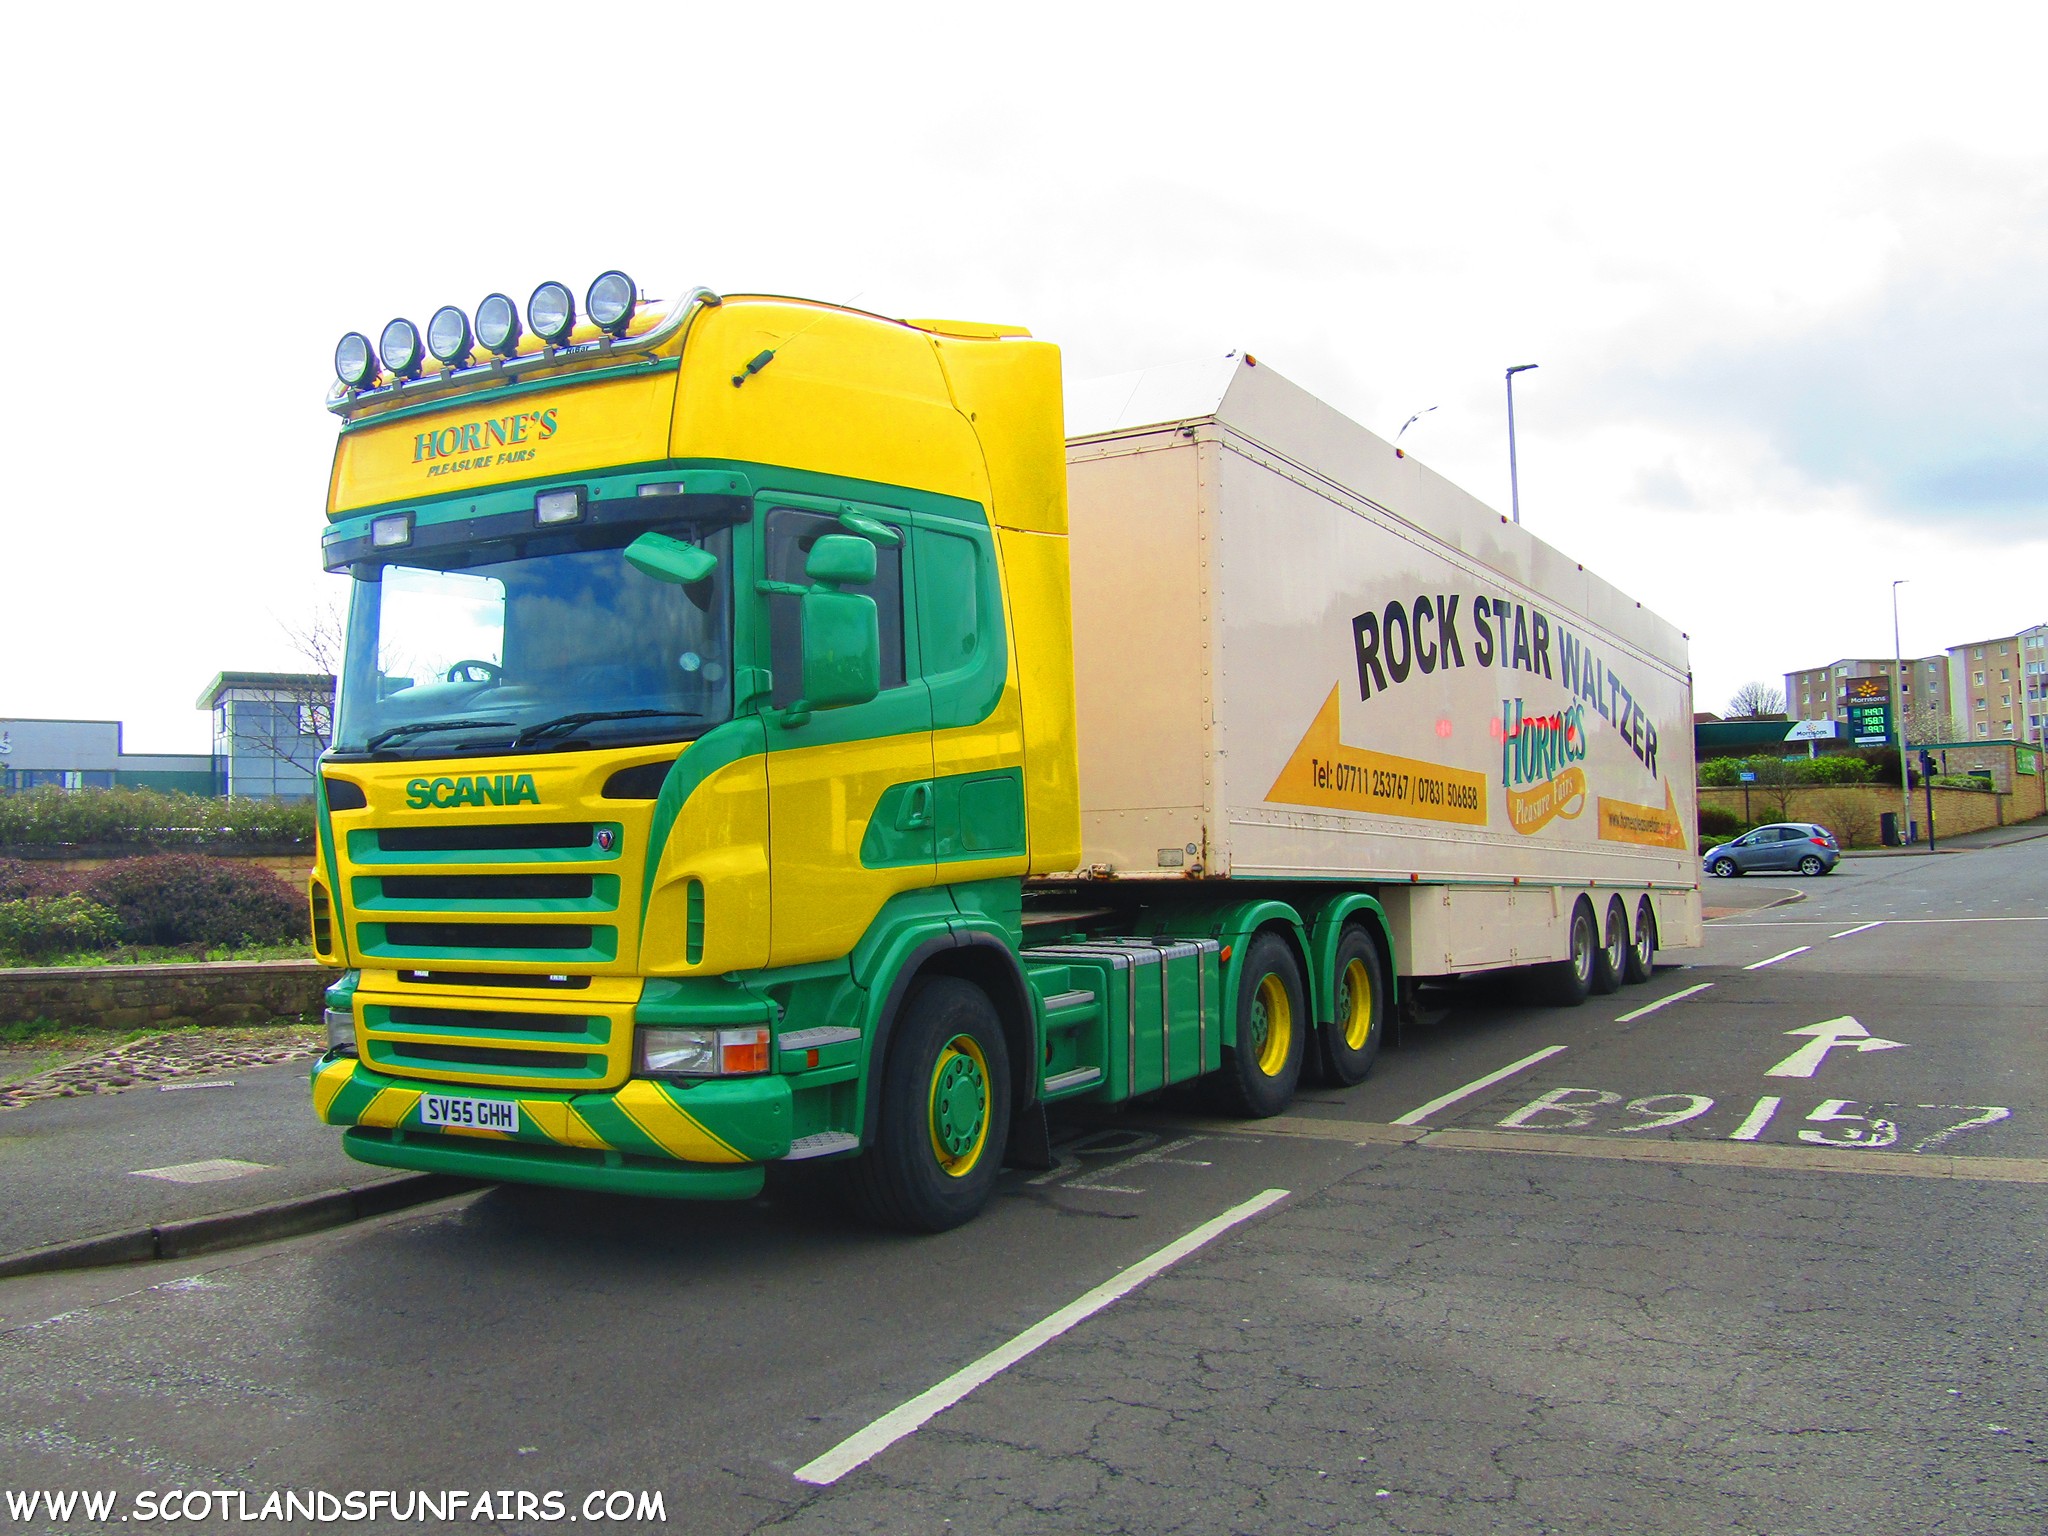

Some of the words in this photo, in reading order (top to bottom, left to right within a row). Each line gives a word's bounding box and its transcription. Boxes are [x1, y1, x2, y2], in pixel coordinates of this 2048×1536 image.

[411, 408, 558, 463] HORNE'S
[426, 455, 493, 478] PLEASURE
[496, 448, 537, 465] FAIRS
[1352, 594, 1465, 702] ROCK
[1473, 595, 1552, 680] STAR
[1557, 625, 1658, 781] WALTZER
[1850, 696, 1886, 704] Morrisons
[405, 774, 541, 809] SCANIA
[1312, 759, 1333, 790] Tel:
[1336, 763, 1369, 795] 07711
[1373, 770, 1409, 801] 253767
[1418, 777, 1445, 805] 07831
[1447, 783, 1478, 810] 506858
[1515, 794, 1550, 825] Pleasure
[1552, 774, 1574, 805] Fairs
[428, 1098, 473, 1123] SV55
[477, 1102, 512, 1127] GHH
[1495, 1087, 2011, 1153] B9157
